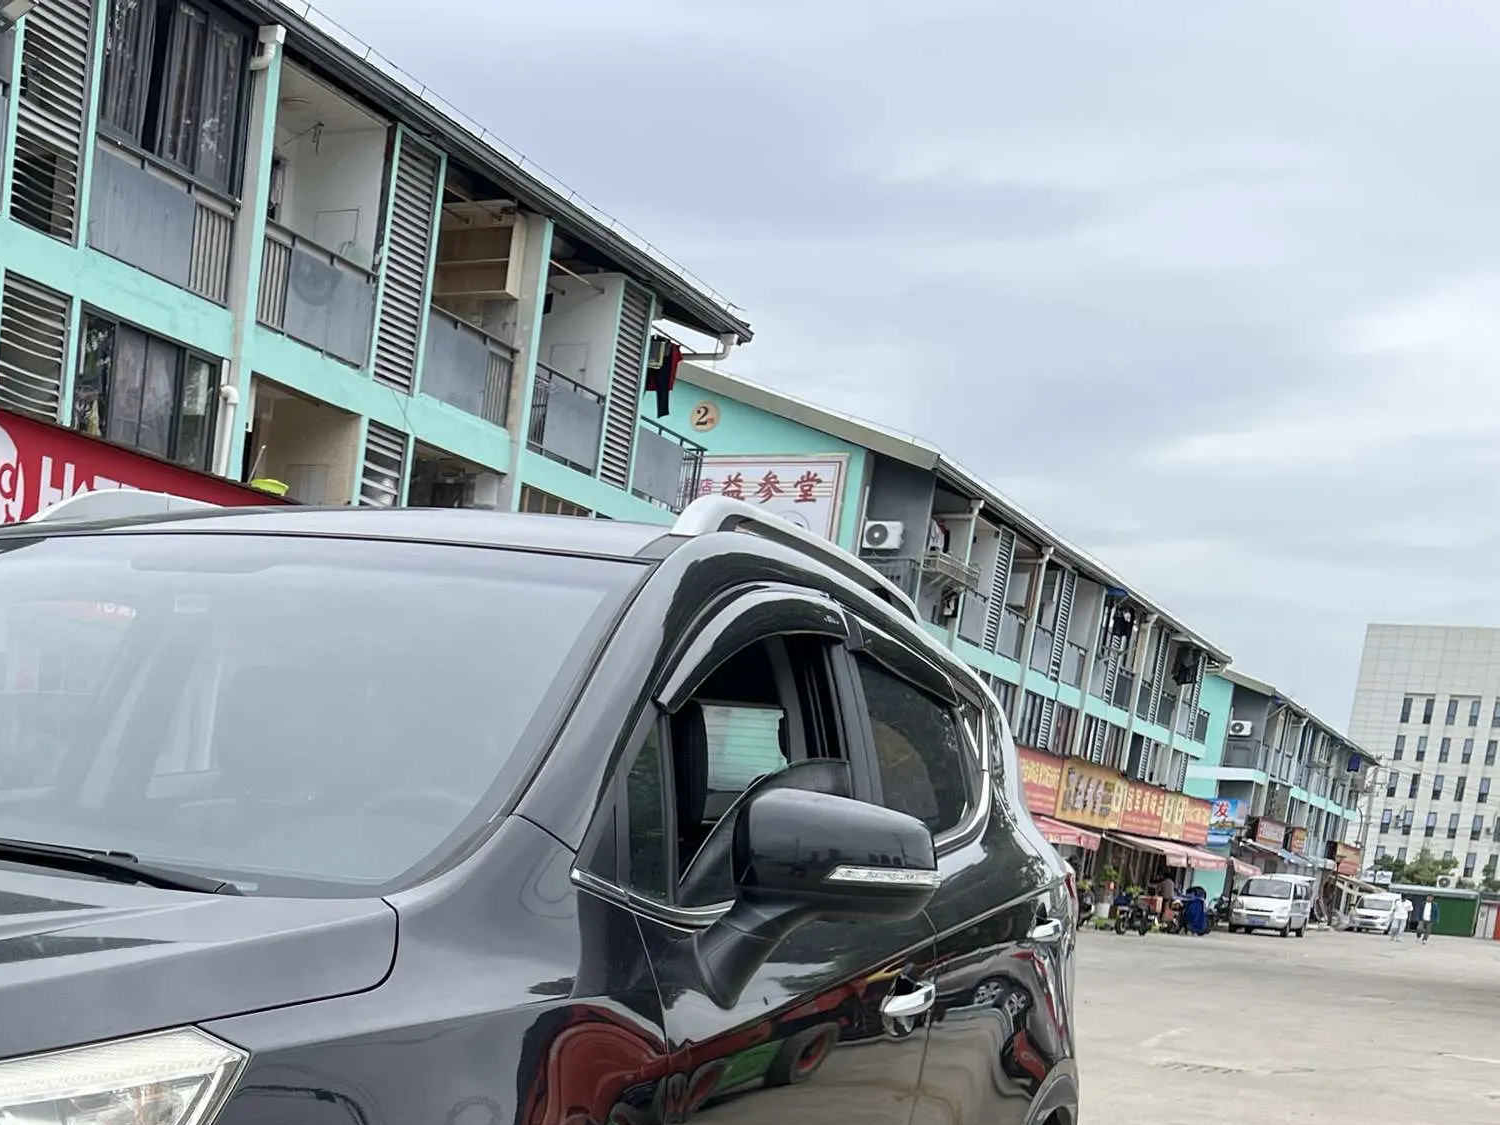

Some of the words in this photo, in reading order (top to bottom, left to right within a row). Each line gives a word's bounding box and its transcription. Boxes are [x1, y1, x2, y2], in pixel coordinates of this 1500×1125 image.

[695, 405, 709, 427] 2
[721, 470, 824, 504] 益参堂
